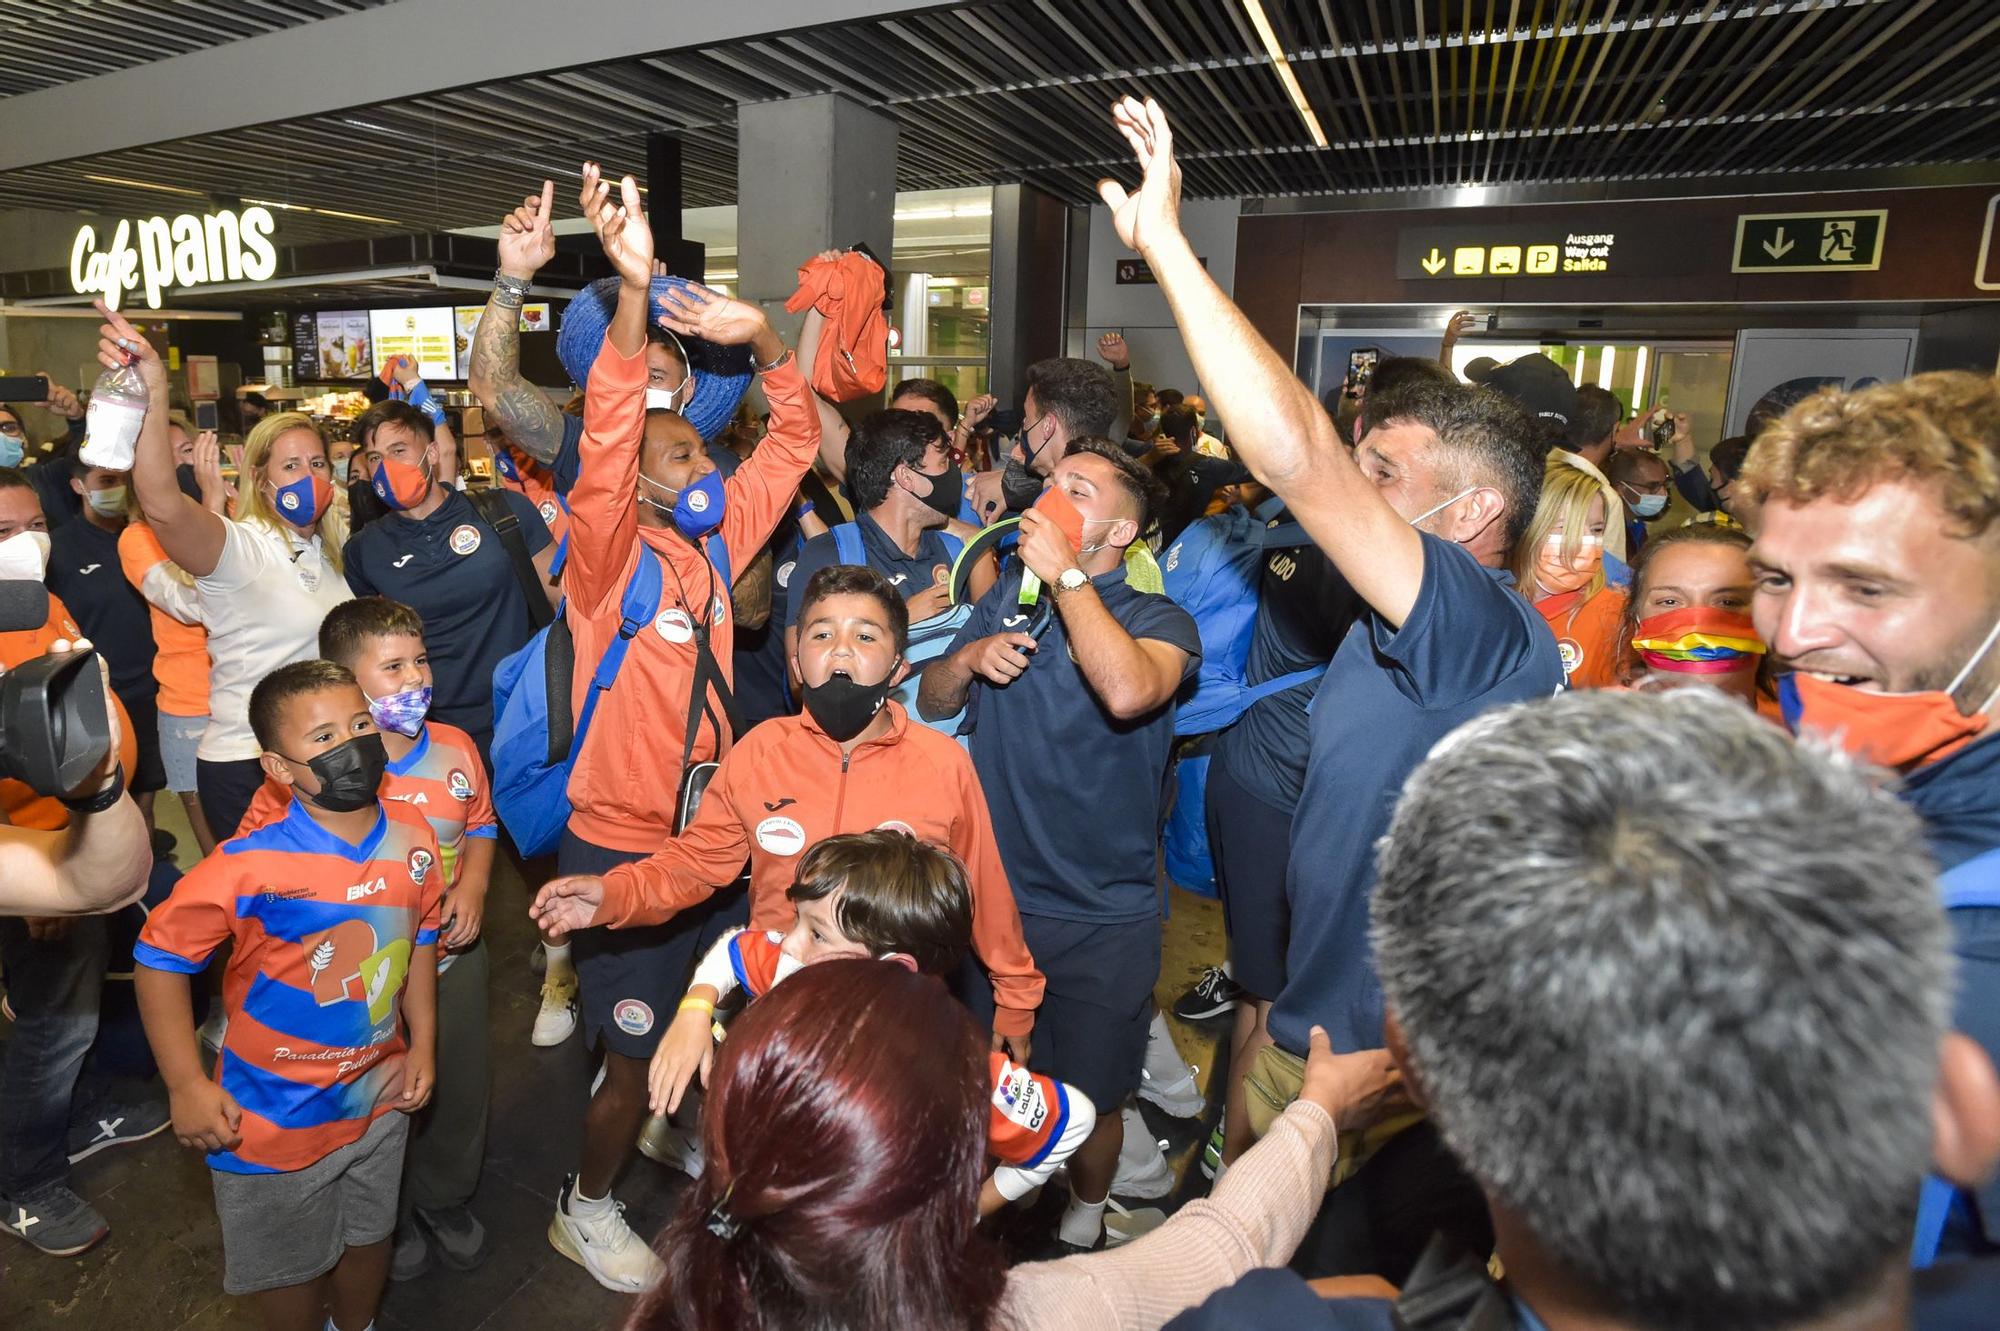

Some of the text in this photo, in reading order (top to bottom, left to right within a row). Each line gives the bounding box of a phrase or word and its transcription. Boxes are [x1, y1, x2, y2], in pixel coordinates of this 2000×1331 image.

[1565, 233, 1615, 246] Ausgang
[137, 206, 277, 310] pans
[1565, 245, 1610, 259] Way out
[1563, 258, 1608, 272] Salida
[346, 877, 387, 901] BKA
[273, 1047, 357, 1062] Panadería
[336, 1049, 379, 1078] Pulido
[1018, 1079, 1035, 1115] LaLiga
